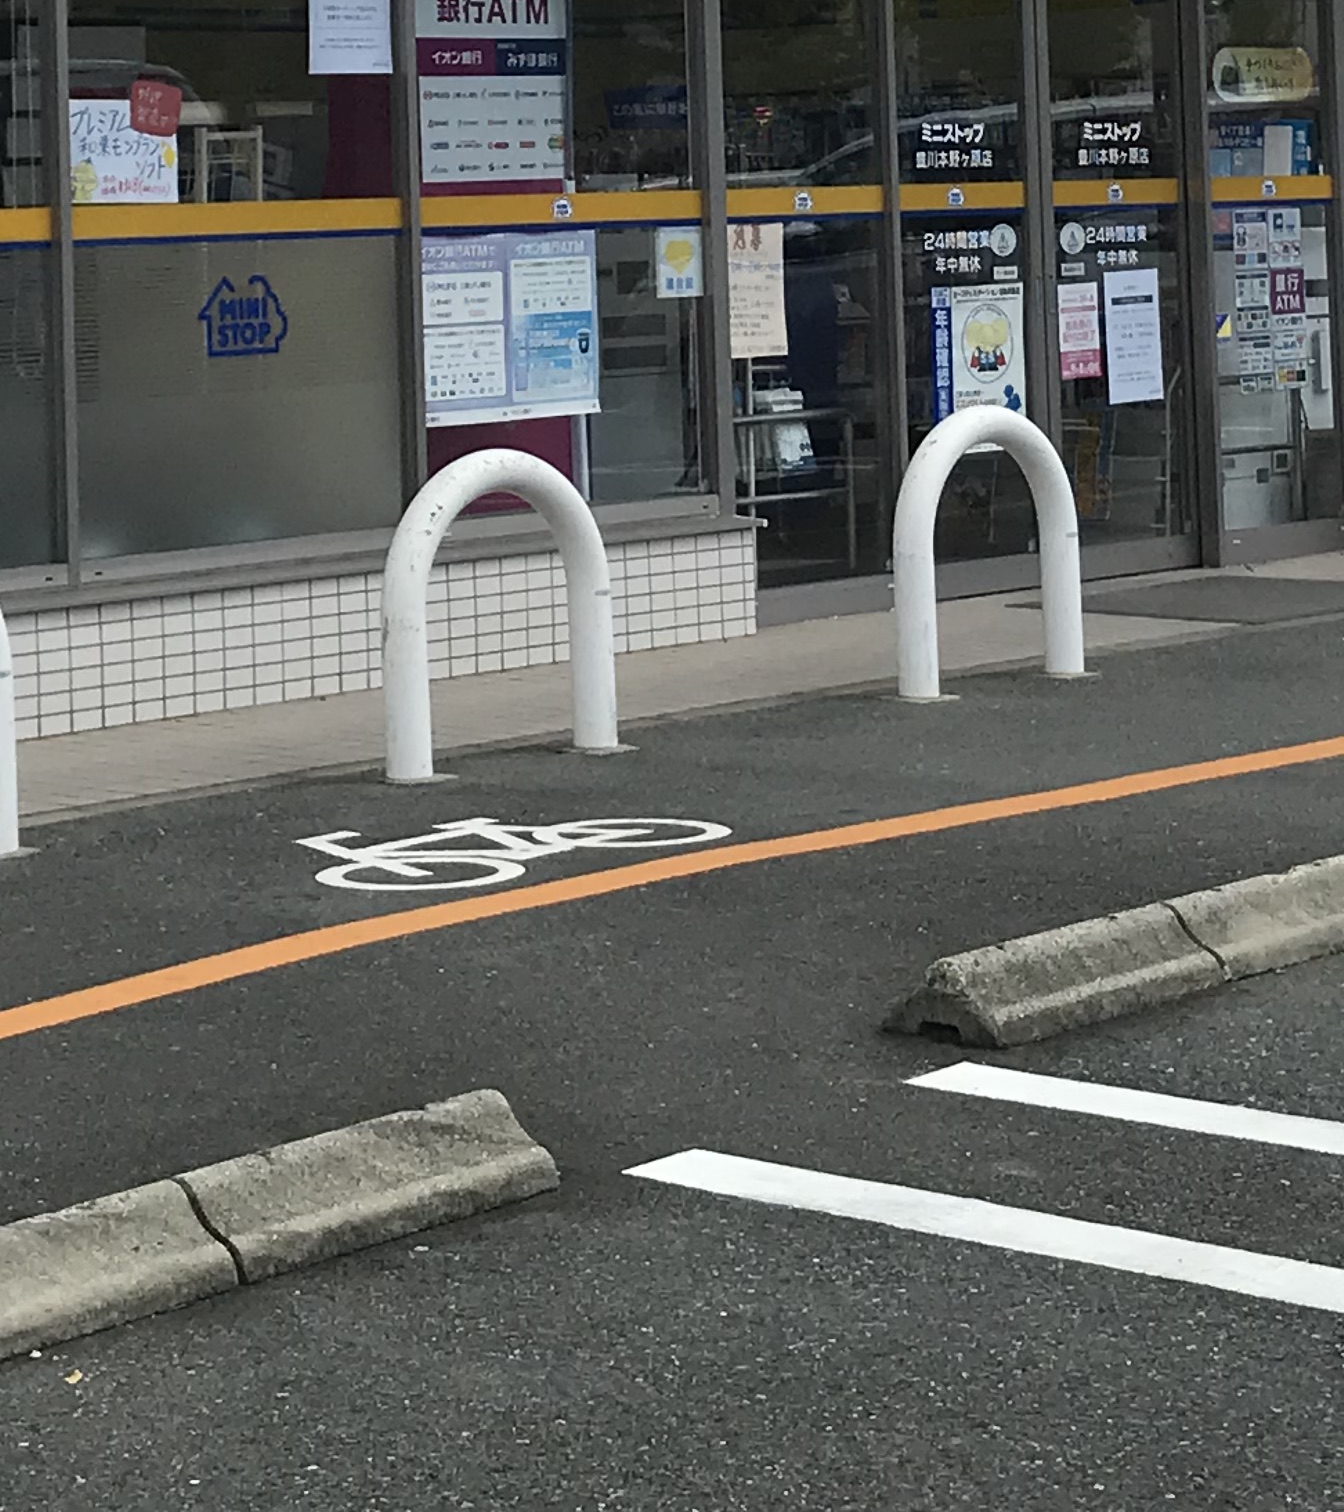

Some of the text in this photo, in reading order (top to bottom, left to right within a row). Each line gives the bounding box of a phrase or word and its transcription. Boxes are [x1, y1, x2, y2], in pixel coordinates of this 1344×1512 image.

[920, 121, 985, 144] ミニストップ
[1082, 120, 1142, 142] ミニストップ
[935, 255, 982, 275] 年中無休
[1096, 249, 1139, 266] 年中無休
[1275, 273, 1300, 292] 銀行
[218, 296, 269, 322] MINI
[1275, 293, 1303, 311] ATM
[216, 322, 272, 349] STOP
